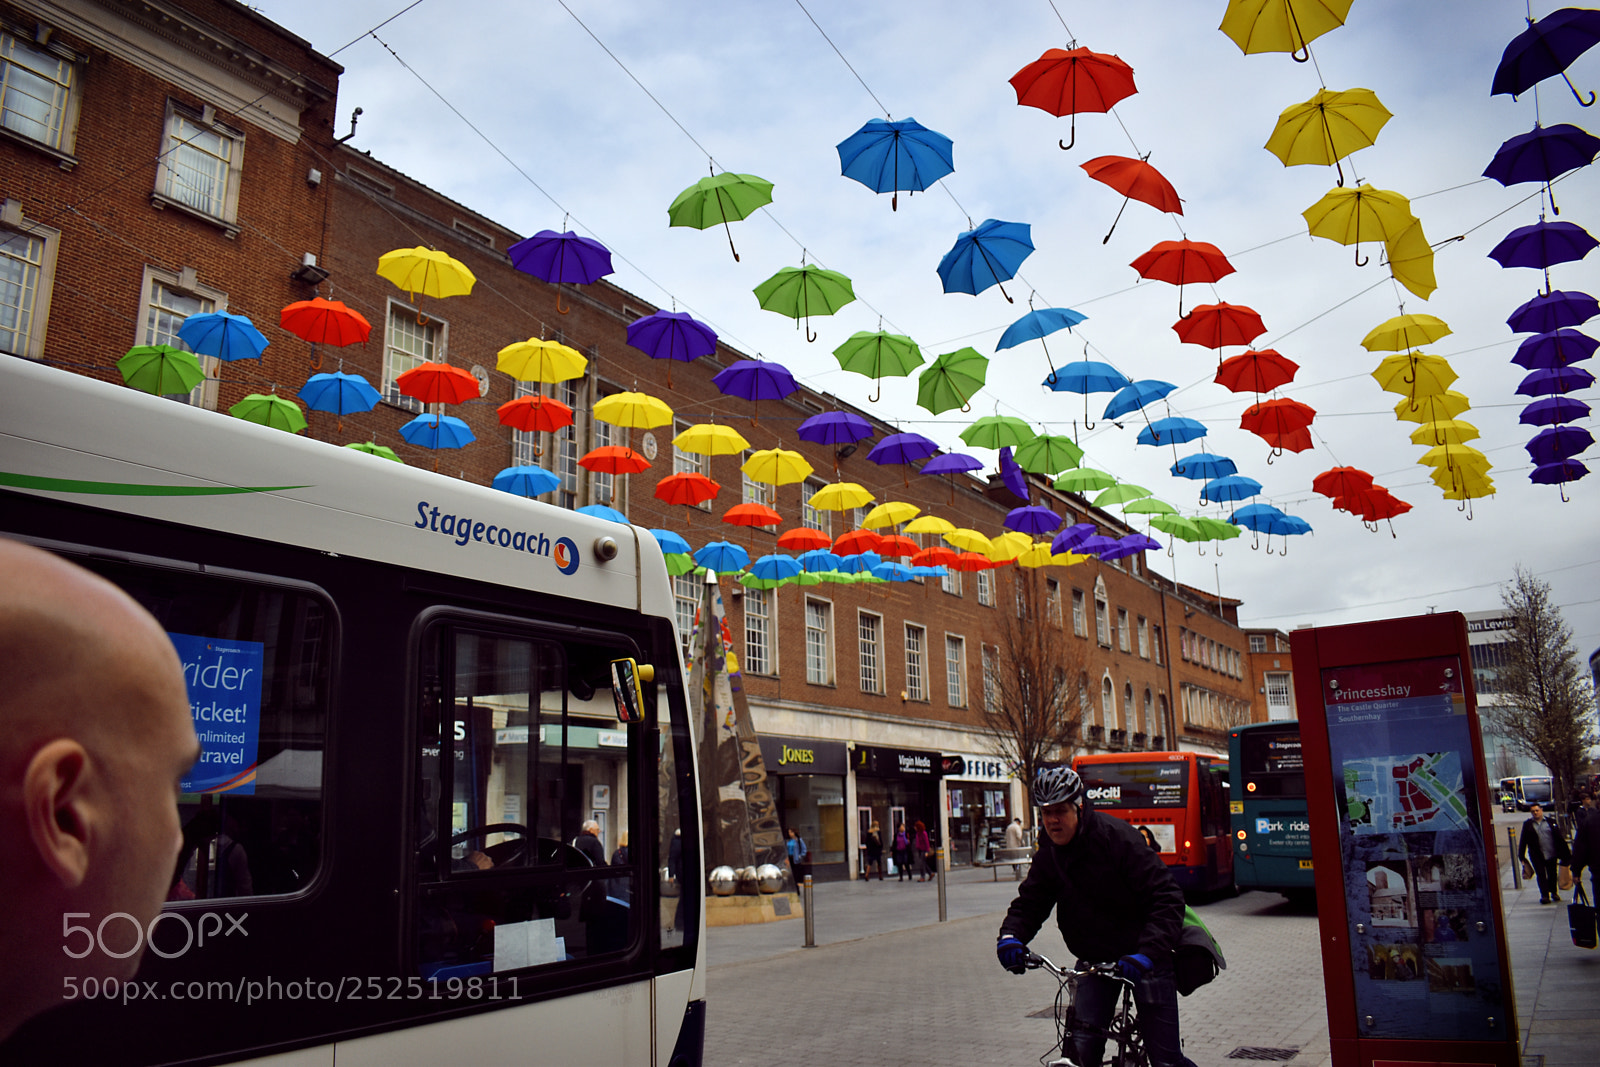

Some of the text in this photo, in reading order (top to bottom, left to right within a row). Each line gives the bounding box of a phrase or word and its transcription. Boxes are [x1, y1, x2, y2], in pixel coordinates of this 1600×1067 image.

[414, 501, 550, 557] Stagecoach
[1335, 684, 1411, 701] Princesshay
[1338, 701, 1399, 713] The Castle Quarter
[1338, 714, 1381, 723] Southernhay
[200, 748, 244, 765] travel
[778, 745, 814, 765] JONES
[898, 754, 931, 768] Virgin Media
[962, 760, 1001, 777] FFICE
[1257, 820, 1284, 832] Park
[1289, 821, 1310, 831] ride
